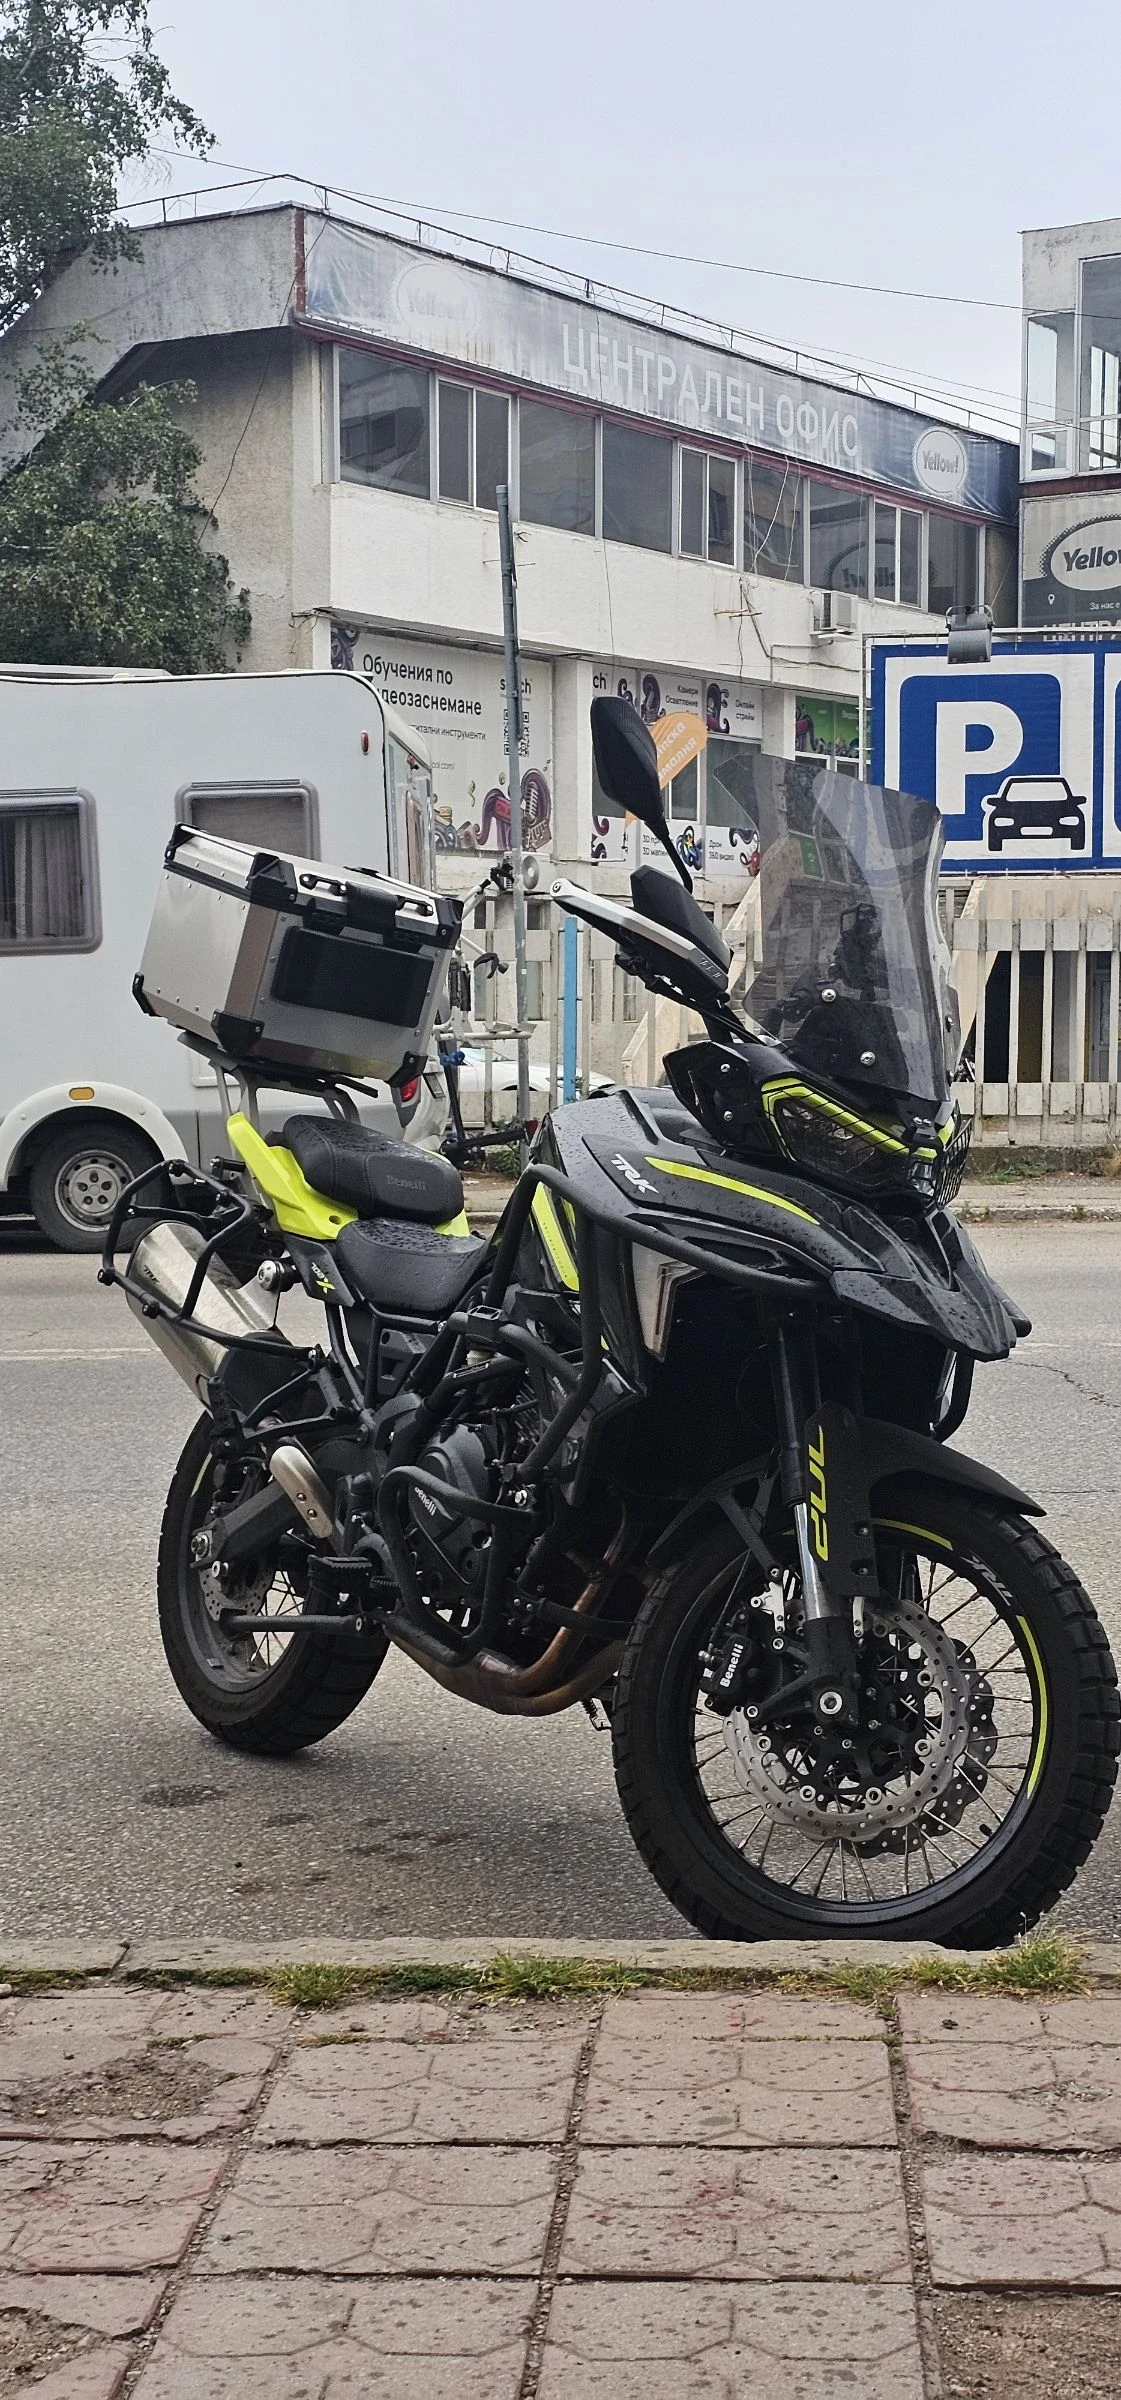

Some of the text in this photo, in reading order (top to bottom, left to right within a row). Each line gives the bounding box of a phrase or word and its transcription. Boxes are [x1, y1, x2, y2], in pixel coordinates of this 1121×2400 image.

[562, 323, 859, 457] ЦЕНТРАЛЕН ОФИС
[922, 450, 959, 474] Yellow!
[1063, 546, 1121, 572] Yello
[363, 654, 453, 685] Обучения по
[377, 688, 482, 716] деозаснемане
[936, 701, 1024, 815] P
[611, 1153, 659, 1194] TRK
[720, 1643, 744, 1688] Benelli
